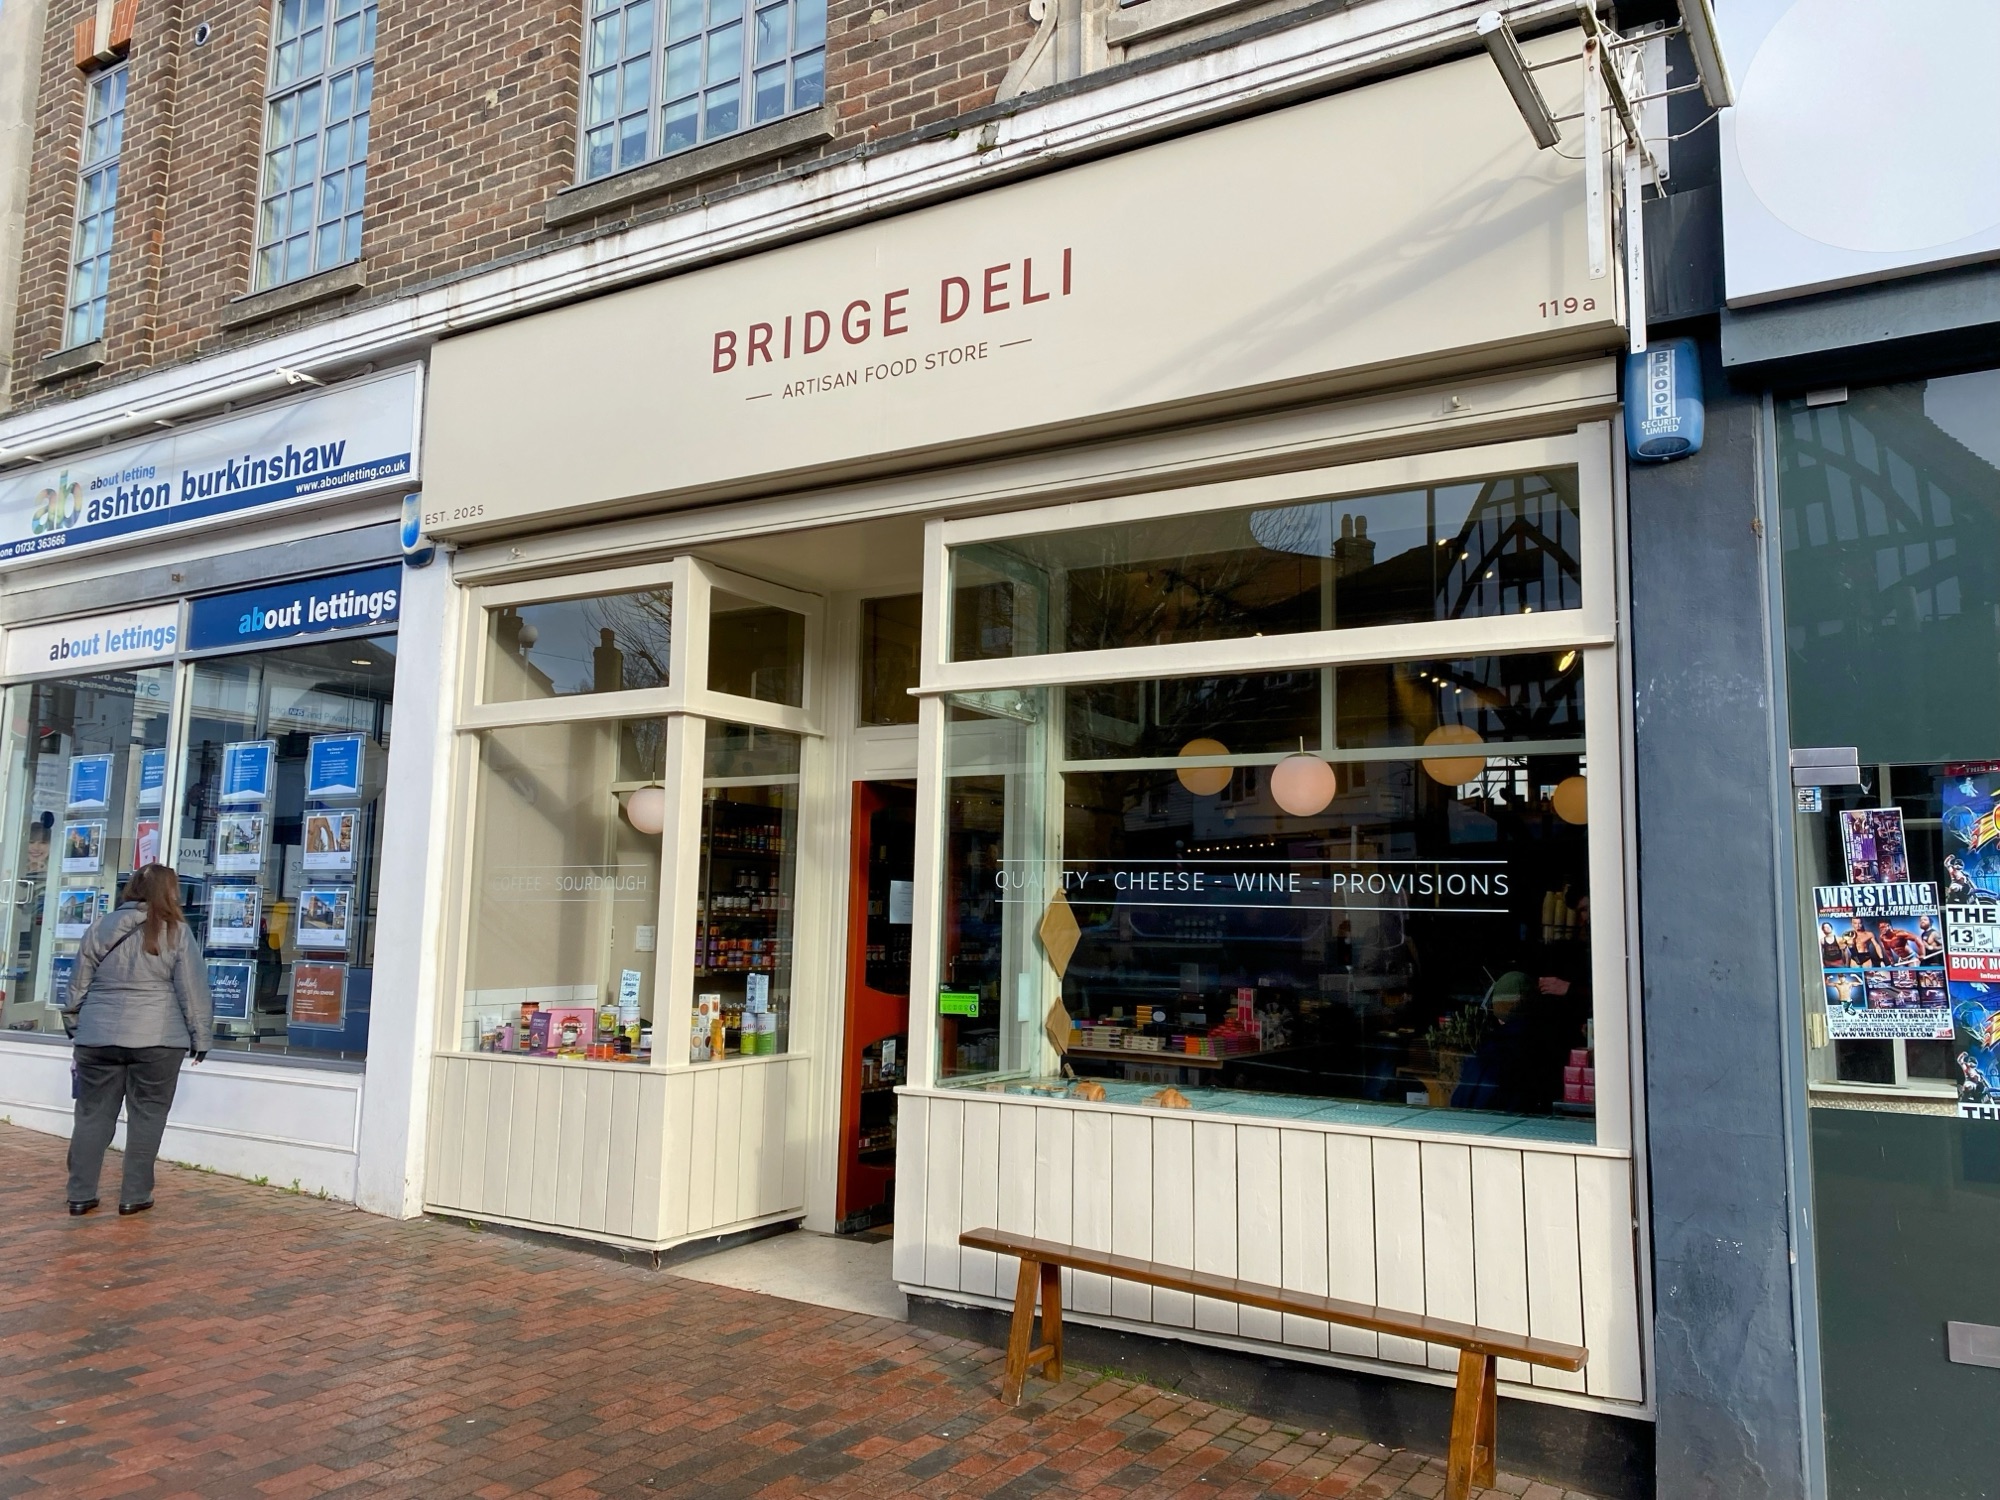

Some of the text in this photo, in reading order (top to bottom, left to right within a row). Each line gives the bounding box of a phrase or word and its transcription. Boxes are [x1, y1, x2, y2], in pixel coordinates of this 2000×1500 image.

[712, 247, 1073, 374] BRIDGE DELI
[1538, 297, 1596, 318] 119a
[782, 342, 989, 400] ARTISAN FOOD STORE
[1655, 352, 1669, 417] BROOK
[1641, 416, 1682, 430] SECURITY
[1646, 424, 1679, 435] LIMITED
[87, 439, 347, 523] ashton burkinshaw
[90, 465, 156, 491] about letting
[295, 459, 406, 494] www.aboutletting.co.uk
[425, 504, 484, 525] EST. 2025
[15, 540, 35, 554] 01732
[37, 534, 67, 550] 363666
[239, 588, 397, 635] about lettings
[49, 624, 176, 662] about lettings
[555, 875, 647, 891] SOURDOUGH
[995, 870, 1089, 890] QUATY
[1114, 872, 1205, 892] CHEESE
[1233, 872, 1301, 893] WINE
[1332, 873, 1510, 896] PROVISIONS
[1819, 884, 1932, 908] WRESTLING
[1948, 908, 1997, 923] THE
[1950, 929, 1973, 943] 13
[1952, 956, 1986, 970] BOOK
[1962, 1106, 2000, 1119] TH
